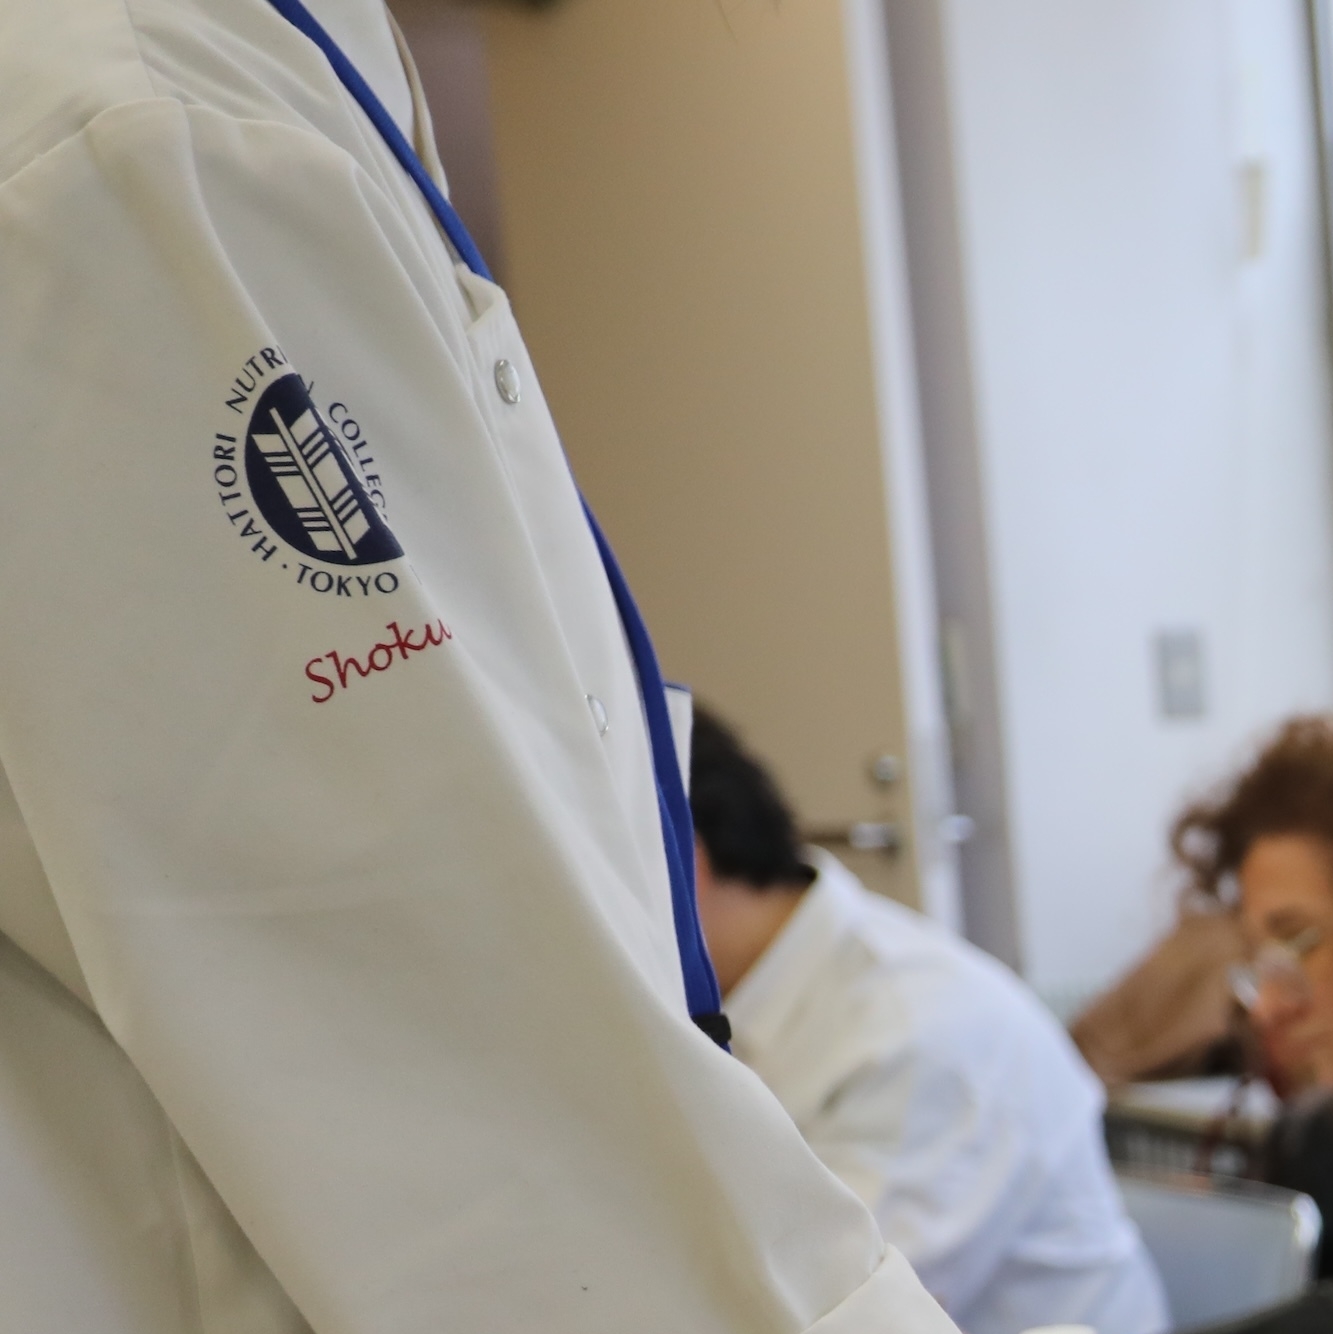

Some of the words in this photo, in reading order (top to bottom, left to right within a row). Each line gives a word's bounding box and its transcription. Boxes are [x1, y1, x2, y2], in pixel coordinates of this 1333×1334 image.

[213, 433, 279, 563] HATTORI
[328, 402, 389, 522] COLLEG
[297, 563, 399, 597] TOKYO
